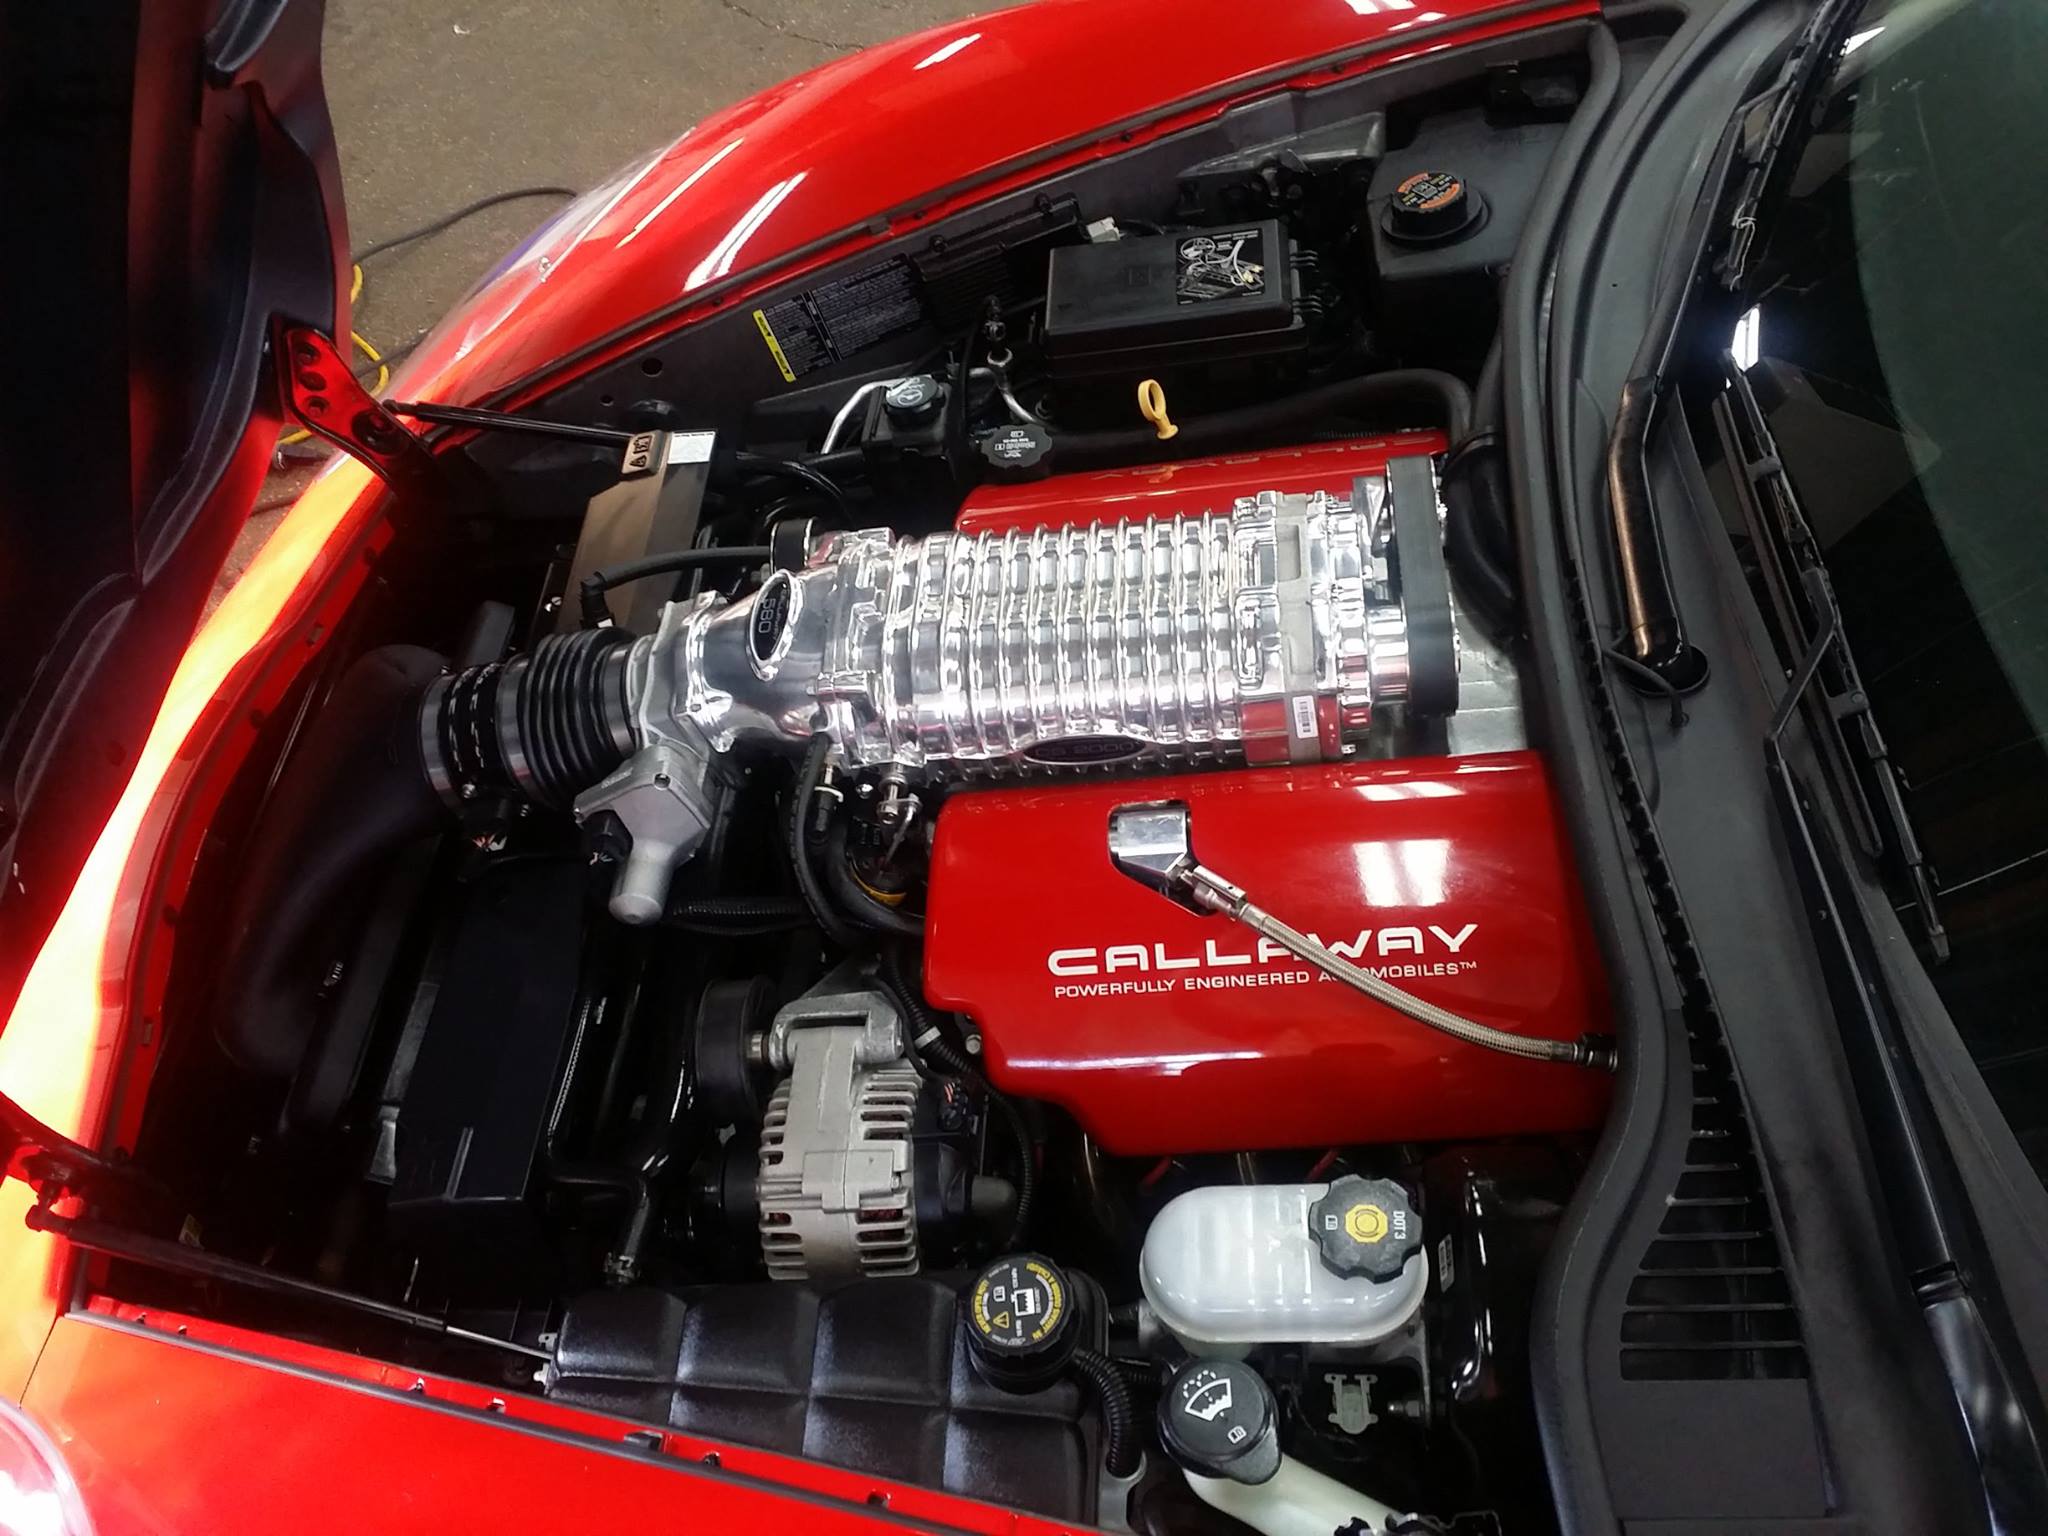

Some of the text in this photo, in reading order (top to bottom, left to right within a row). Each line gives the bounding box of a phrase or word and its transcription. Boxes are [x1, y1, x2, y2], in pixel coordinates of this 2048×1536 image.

[758, 598, 776, 634] 580
[1054, 979, 1177, 998] POWERFULLY
[1183, 971, 1311, 990] ENGINEERED
[1392, 1210, 1406, 1240] DOT 3
